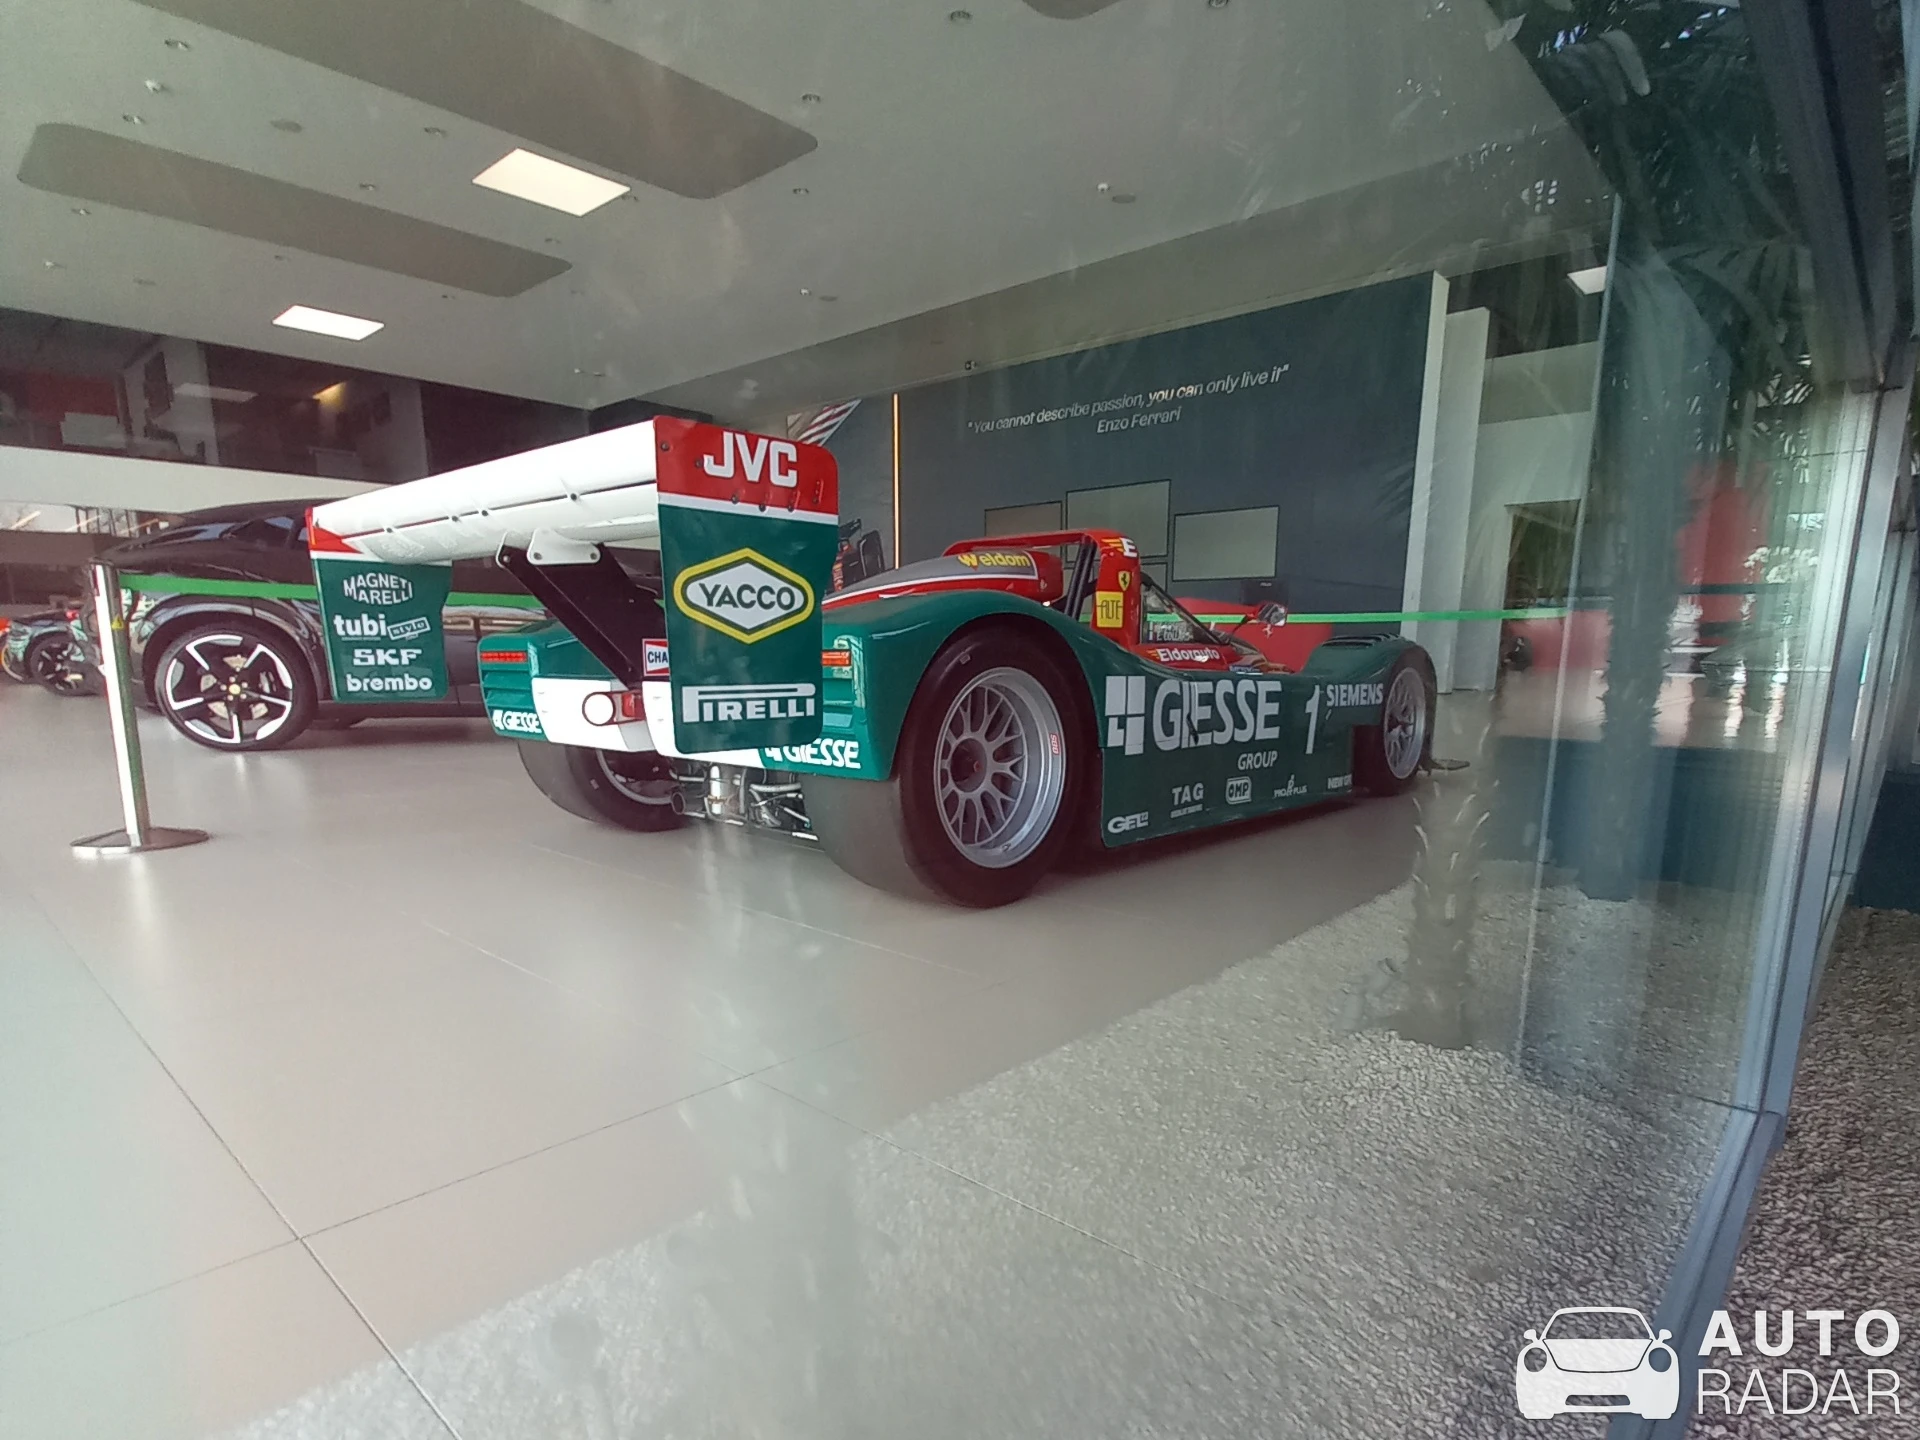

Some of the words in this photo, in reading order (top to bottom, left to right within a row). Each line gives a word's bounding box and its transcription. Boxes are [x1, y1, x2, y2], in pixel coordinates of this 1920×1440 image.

[996, 412, 1034, 429] cannot
[1037, 402, 1090, 424] describe
[1092, 394, 1145, 416] passion,
[1147, 388, 1175, 407] you
[1176, 384, 1203, 399] can
[1206, 374, 1240, 393] only
[1240, 371, 1268, 388] live
[1096, 418, 1129, 434] Enzo
[1131, 406, 1182, 428] Ferrari
[703, 431, 798, 488] JVC
[958, 552, 1031, 570] Weldom
[699, 583, 796, 611] YACCO
[333, 613, 387, 636] tubi
[353, 648, 422, 666] SKF
[1157, 648, 1220, 663] Eldorauto
[346, 673, 433, 691] brembo
[681, 683, 816, 723] PIRELLI
[1326, 683, 1384, 707] SIEMENS
[1152, 679, 1282, 752] GIESSE
[1305, 684, 1320, 754] 1
[783, 737, 862, 770] GIESSE
[1237, 750, 1279, 771] GROUP
[1171, 782, 1204, 806] TAG
[1227, 780, 1250, 800] OMP
